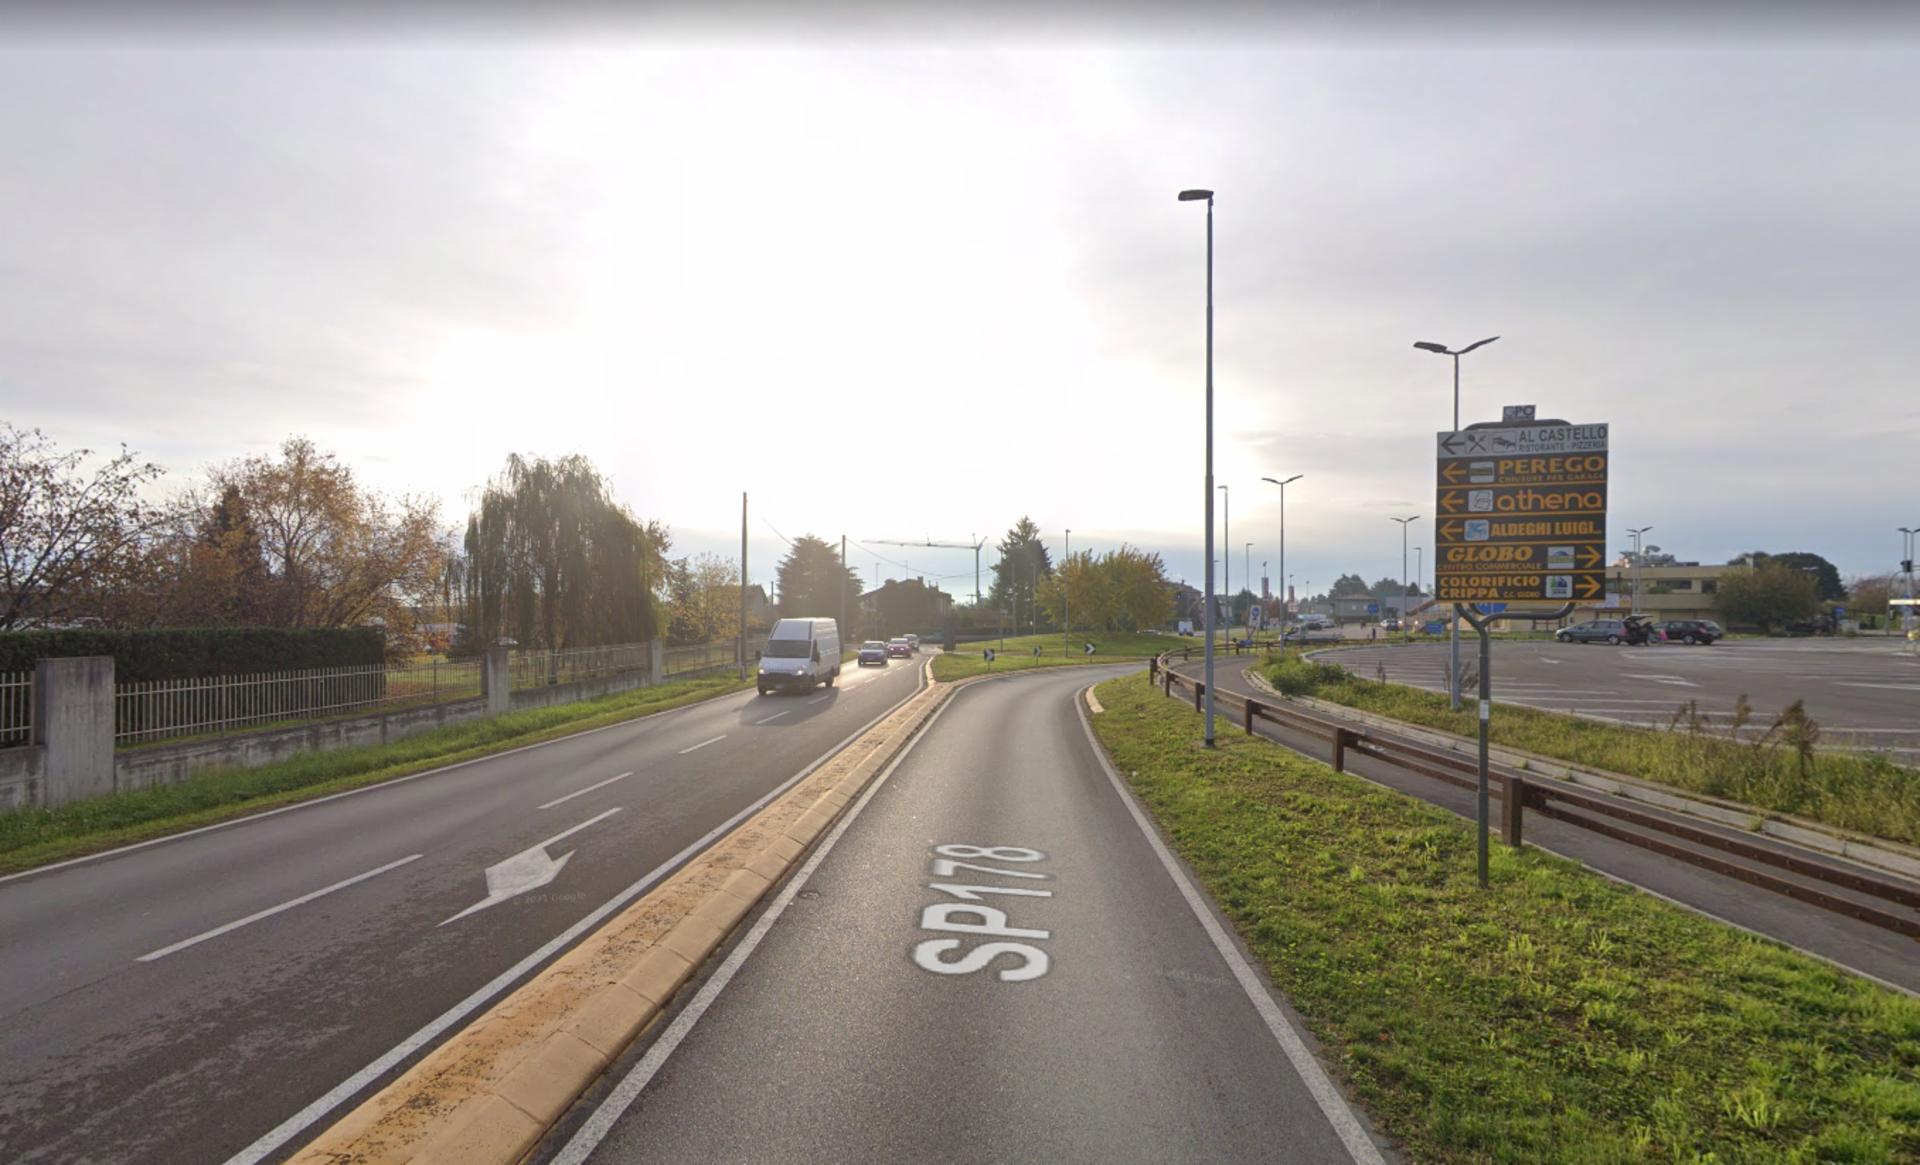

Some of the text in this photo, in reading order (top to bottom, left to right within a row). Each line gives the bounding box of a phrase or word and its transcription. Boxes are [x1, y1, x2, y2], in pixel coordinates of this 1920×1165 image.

[1519, 426, 1607, 442] AL CASTELLO
[1519, 442, 1565, 452] RISTORANTE
[1572, 440, 1605, 450] PIZZERIA
[1499, 456, 1605, 475] PEREGO
[1496, 489, 1602, 511] athena
[1491, 522, 1550, 537] ALDEGHI
[1555, 521, 1595, 535] LUIGI
[1447, 546, 1533, 562] GLOBO
[1437, 561, 1542, 571] CENTRO COMMERCIALE
[1440, 576, 1541, 588] COLORIFICIO
[1440, 587, 1499, 598] CRIPPA
[914, 844, 1052, 981] SP178
